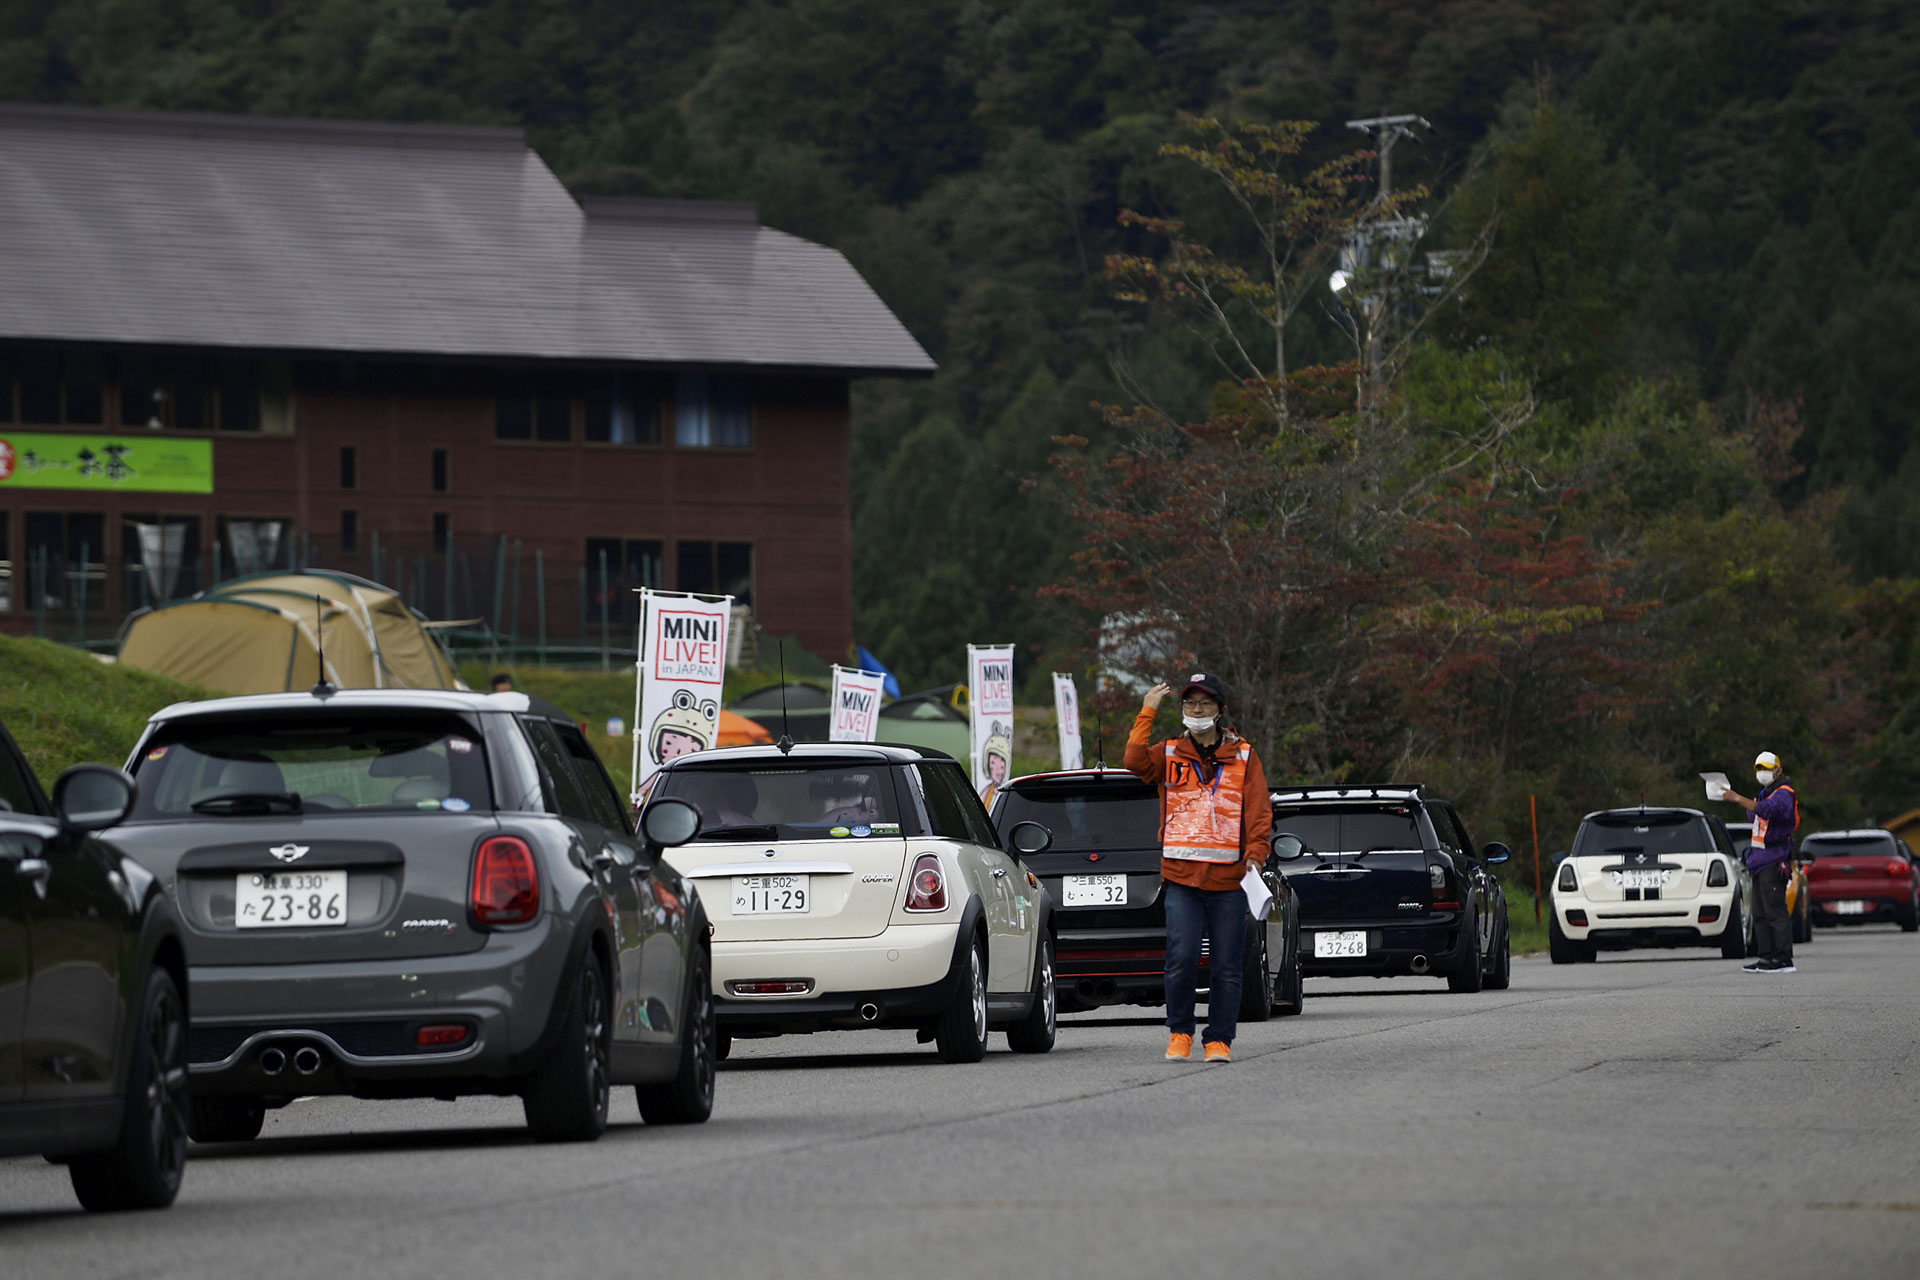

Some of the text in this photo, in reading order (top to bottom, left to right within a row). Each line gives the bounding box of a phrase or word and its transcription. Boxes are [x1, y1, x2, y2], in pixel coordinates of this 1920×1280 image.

[664, 617, 717, 642] MINI
[663, 640, 717, 665] LIVE!
[662, 664, 717, 677] in JAPAN.
[983, 664, 1010, 681] MINI
[861, 873, 894, 884] COOPER
[261, 893, 340, 922] 23-86
[736, 889, 805, 911] め 11-29
[1327, 941, 1364, 955] 32-68
